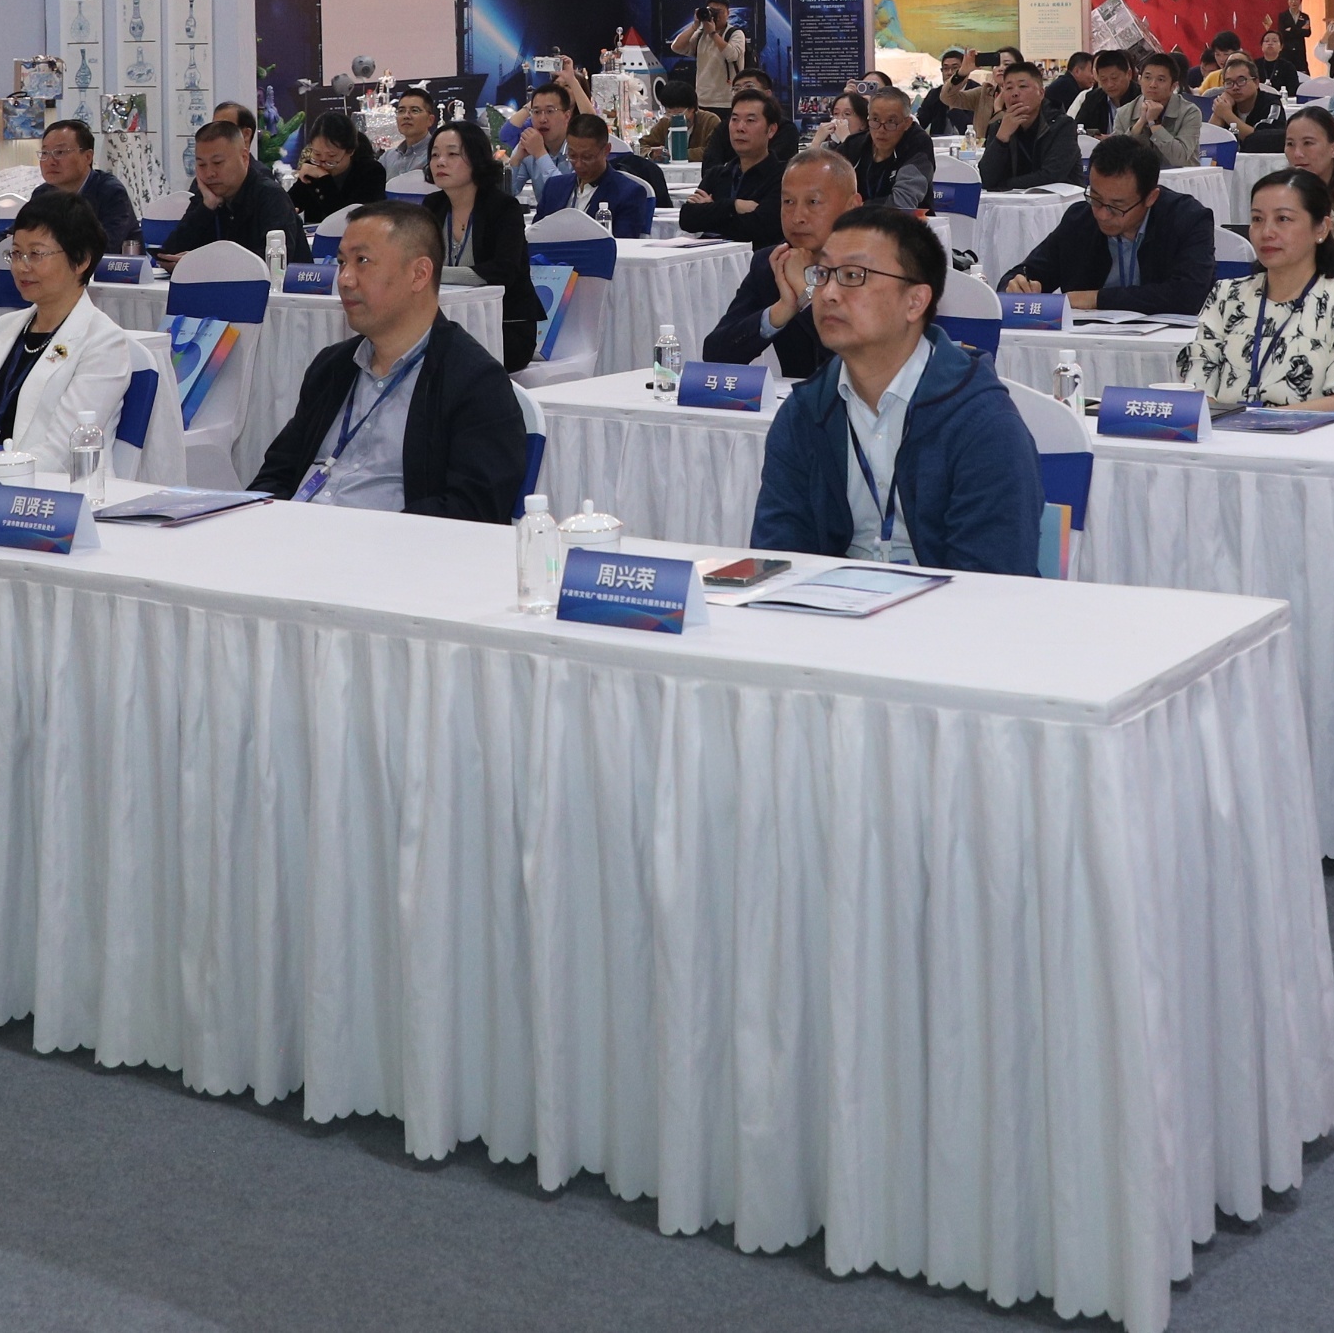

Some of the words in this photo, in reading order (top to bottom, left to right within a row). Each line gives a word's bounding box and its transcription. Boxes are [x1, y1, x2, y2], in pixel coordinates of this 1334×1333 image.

[1012, 302, 1042, 315] 王挺
[704, 374, 738, 391] 马军
[1125, 400, 1174, 419] 宋萍萍
[10, 495, 56, 519] 周贤丰
[596, 563, 657, 592] 周兴荣
